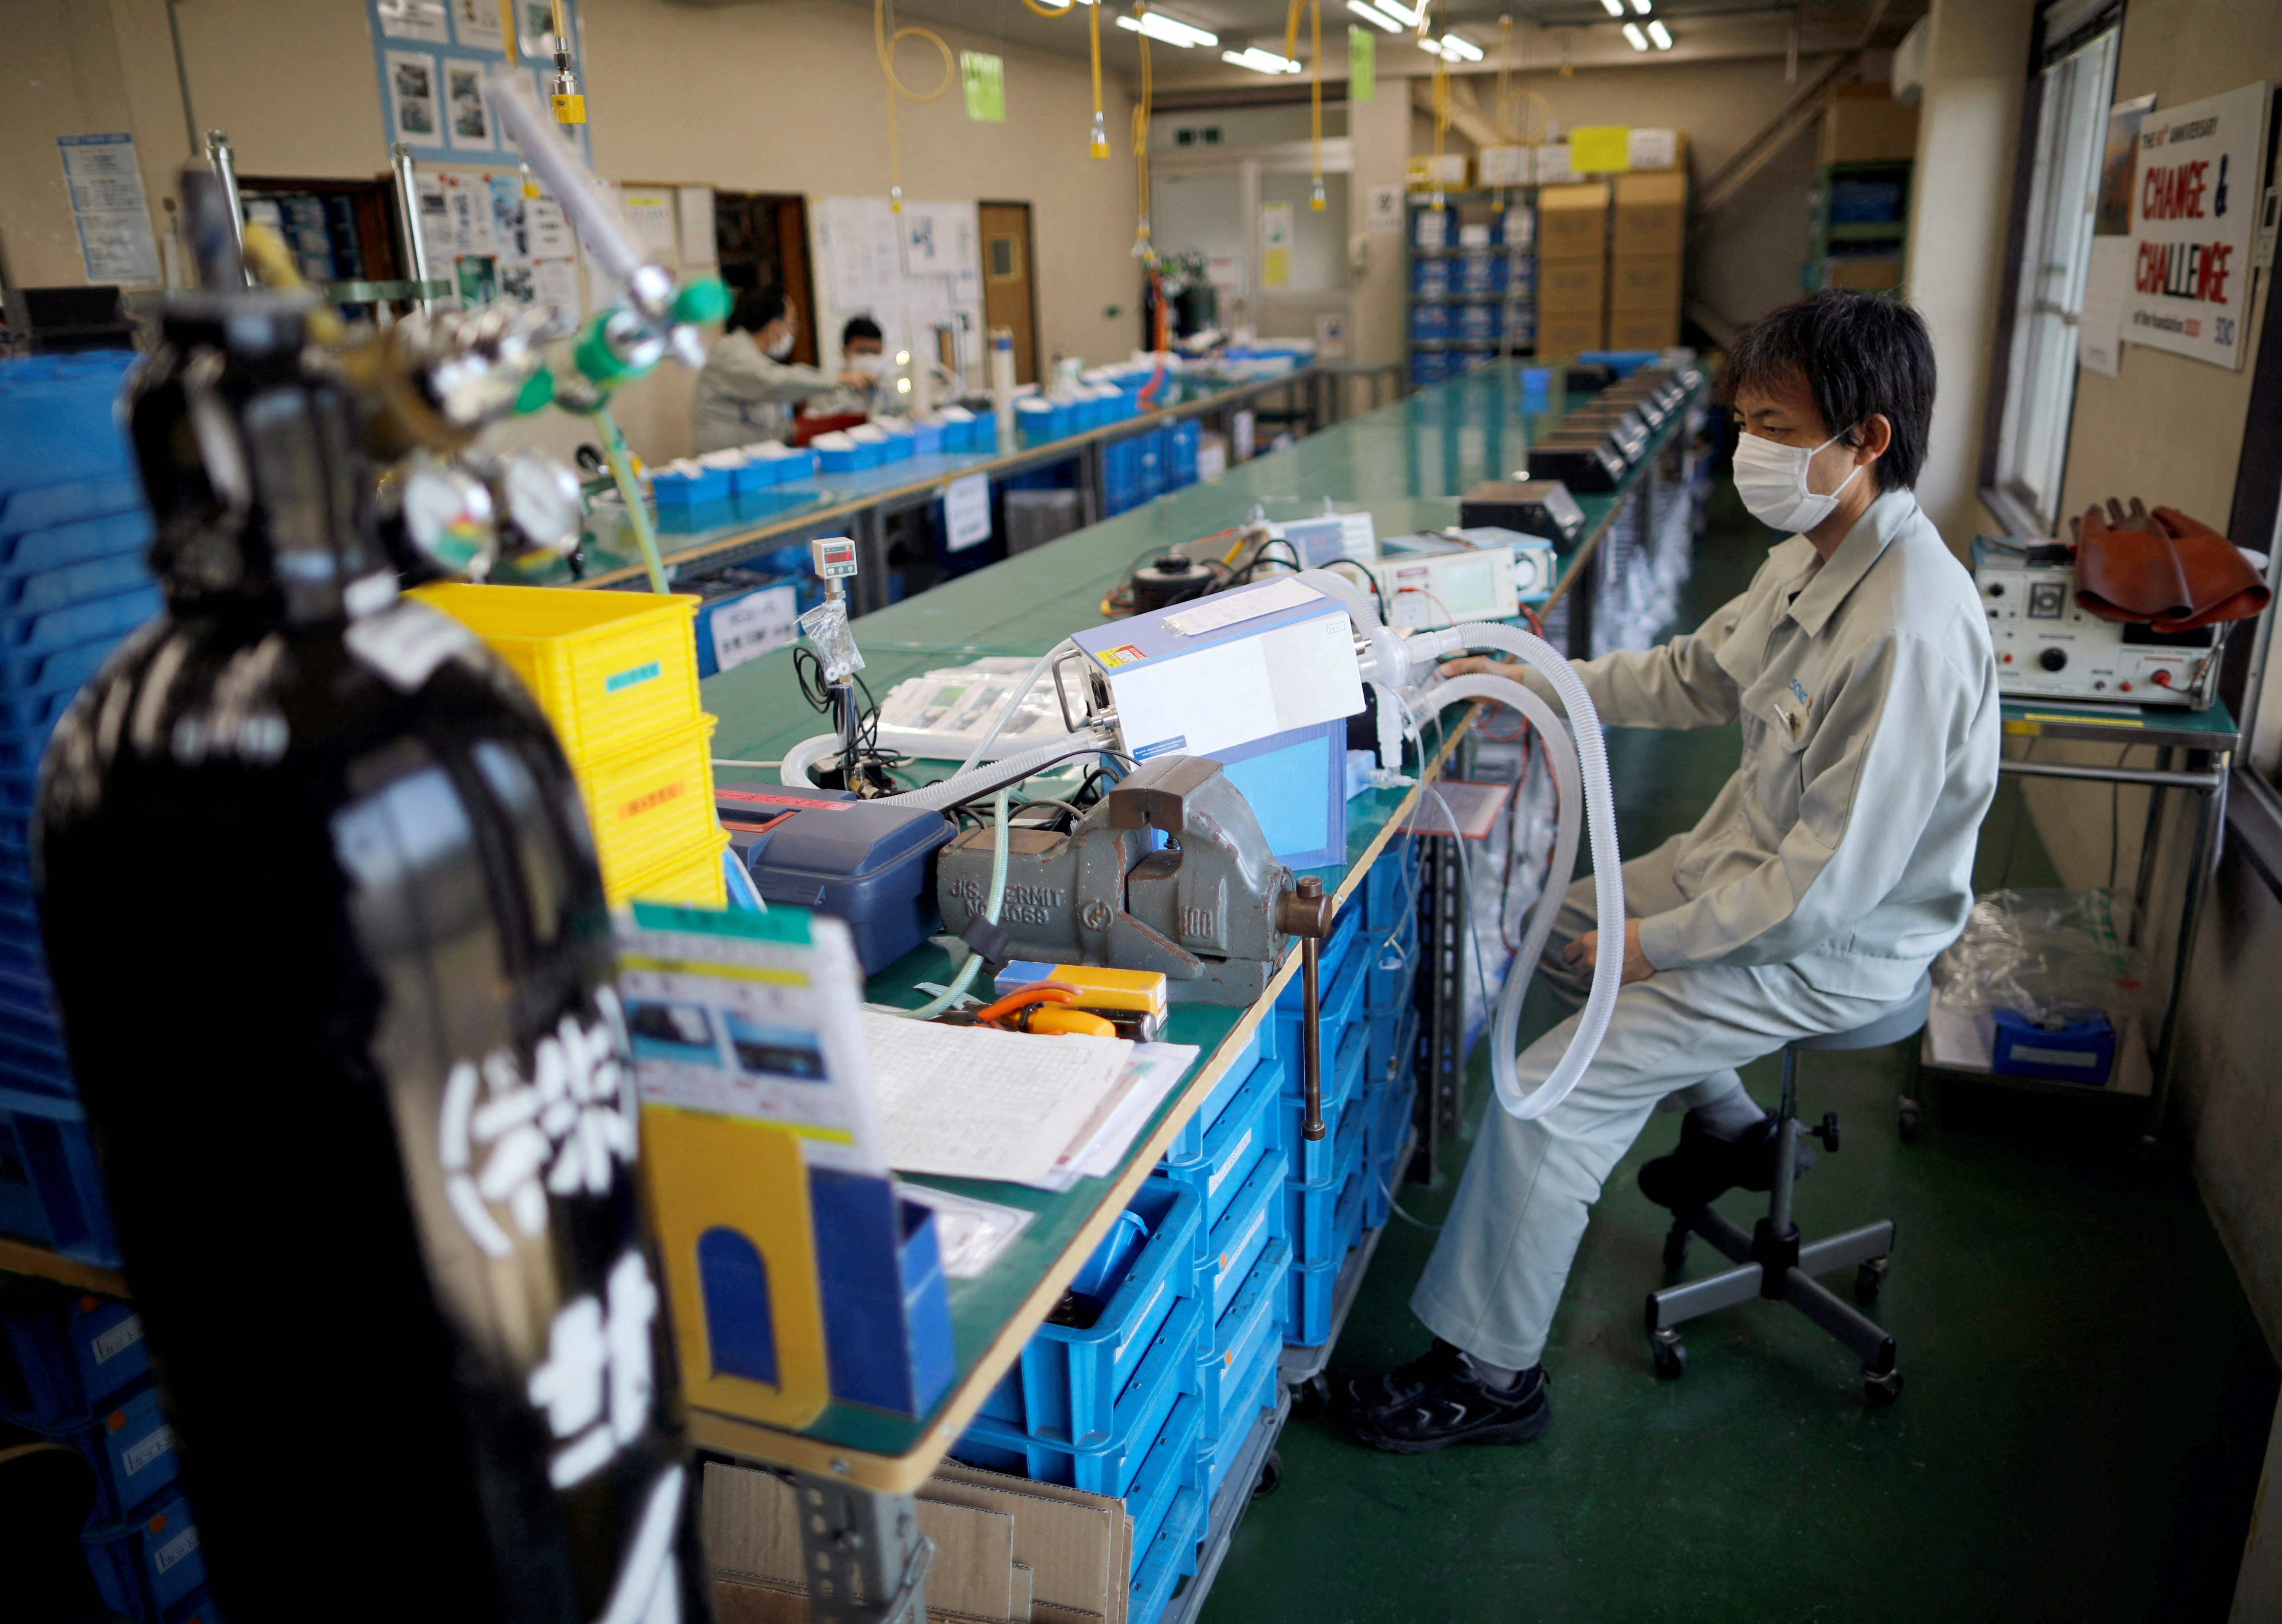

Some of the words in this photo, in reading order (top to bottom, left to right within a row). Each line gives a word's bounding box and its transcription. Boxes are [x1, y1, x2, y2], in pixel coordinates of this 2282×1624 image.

[2142, 160, 2210, 219] CHANGE
[2214, 153, 2228, 217] &
[2135, 240, 2233, 304] CHALLENGE
[1004, 883, 1065, 908] ERMIT
[1182, 906, 1213, 939] 100
